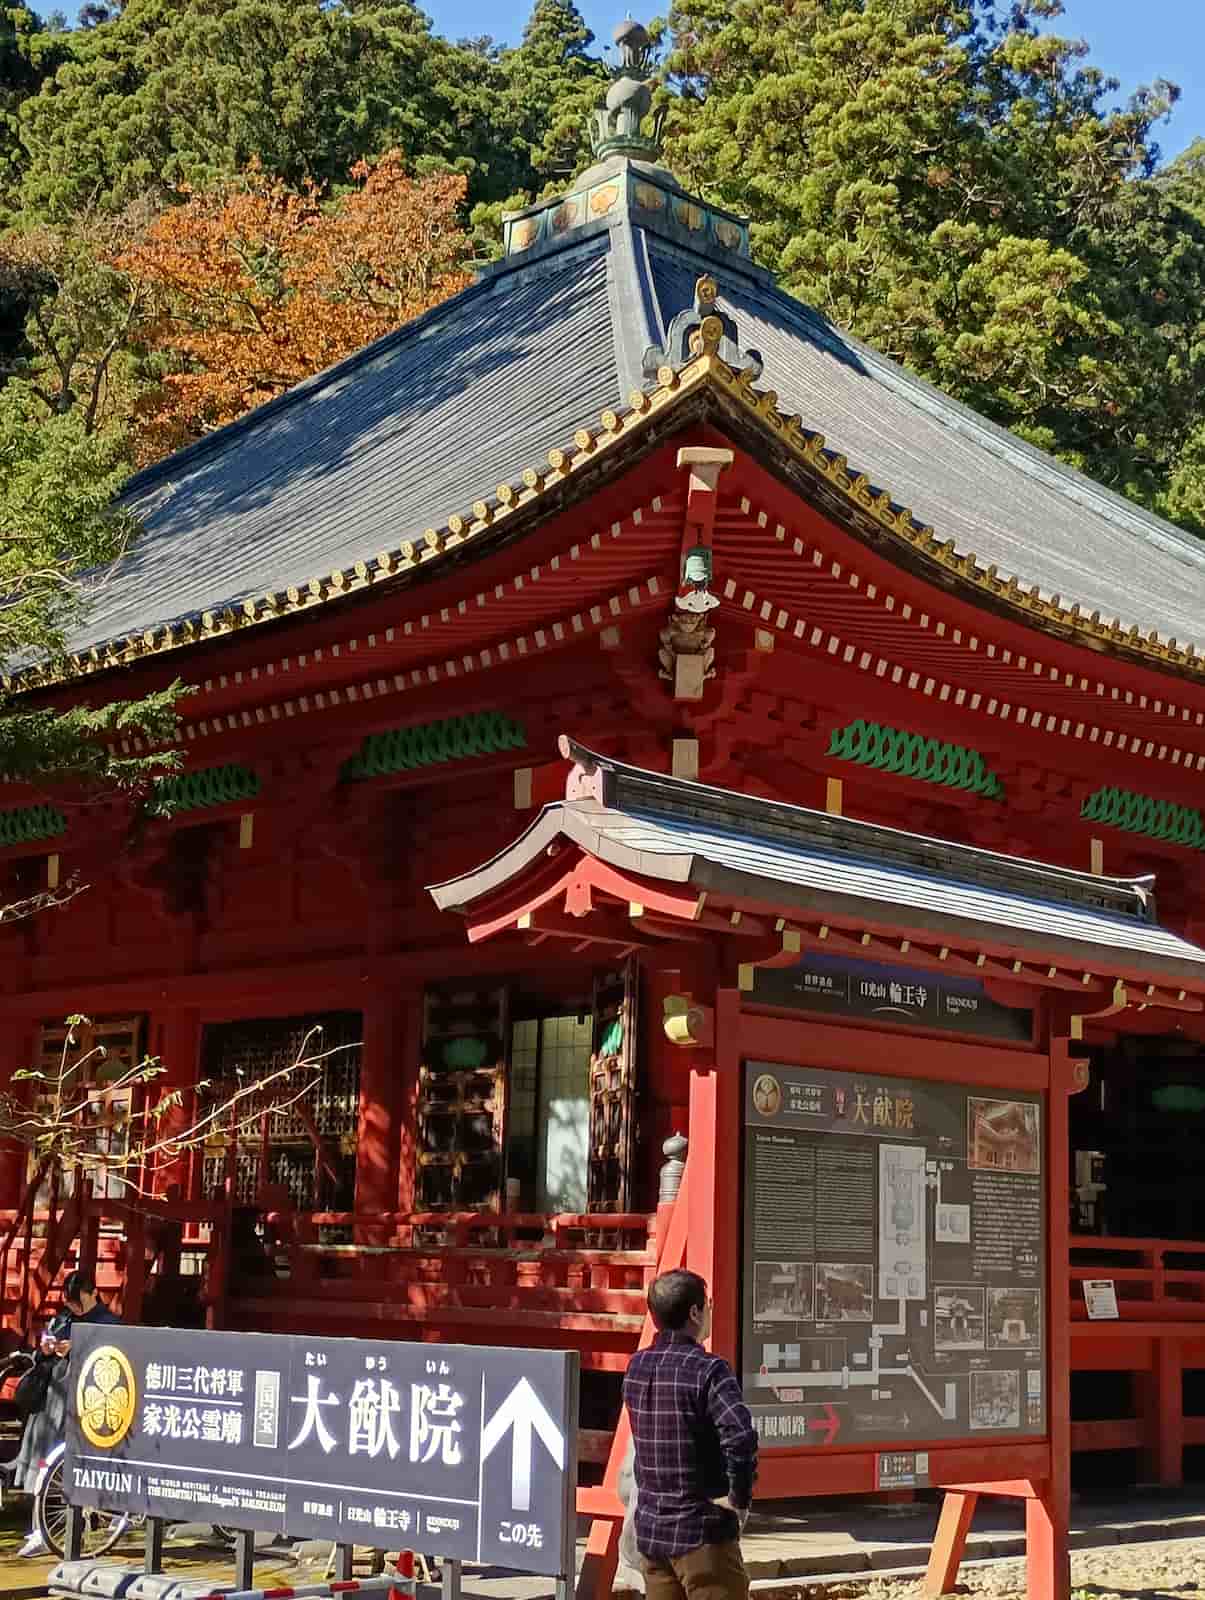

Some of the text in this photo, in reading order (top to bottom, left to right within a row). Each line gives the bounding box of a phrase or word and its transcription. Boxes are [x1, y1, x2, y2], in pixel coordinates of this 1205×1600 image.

[889, 981, 928, 1008] 輪王寺
[304, 1351, 328, 1367] たい
[426, 1360, 450, 1375] いん
[145, 1362, 244, 1397] 徳川三代将軍
[142, 1403, 244, 1445] 家光公霊廟
[287, 1374, 465, 1466] 大猷院
[72, 1468, 133, 1493] TAIYUIN
[497, 1521, 544, 1548] この先
